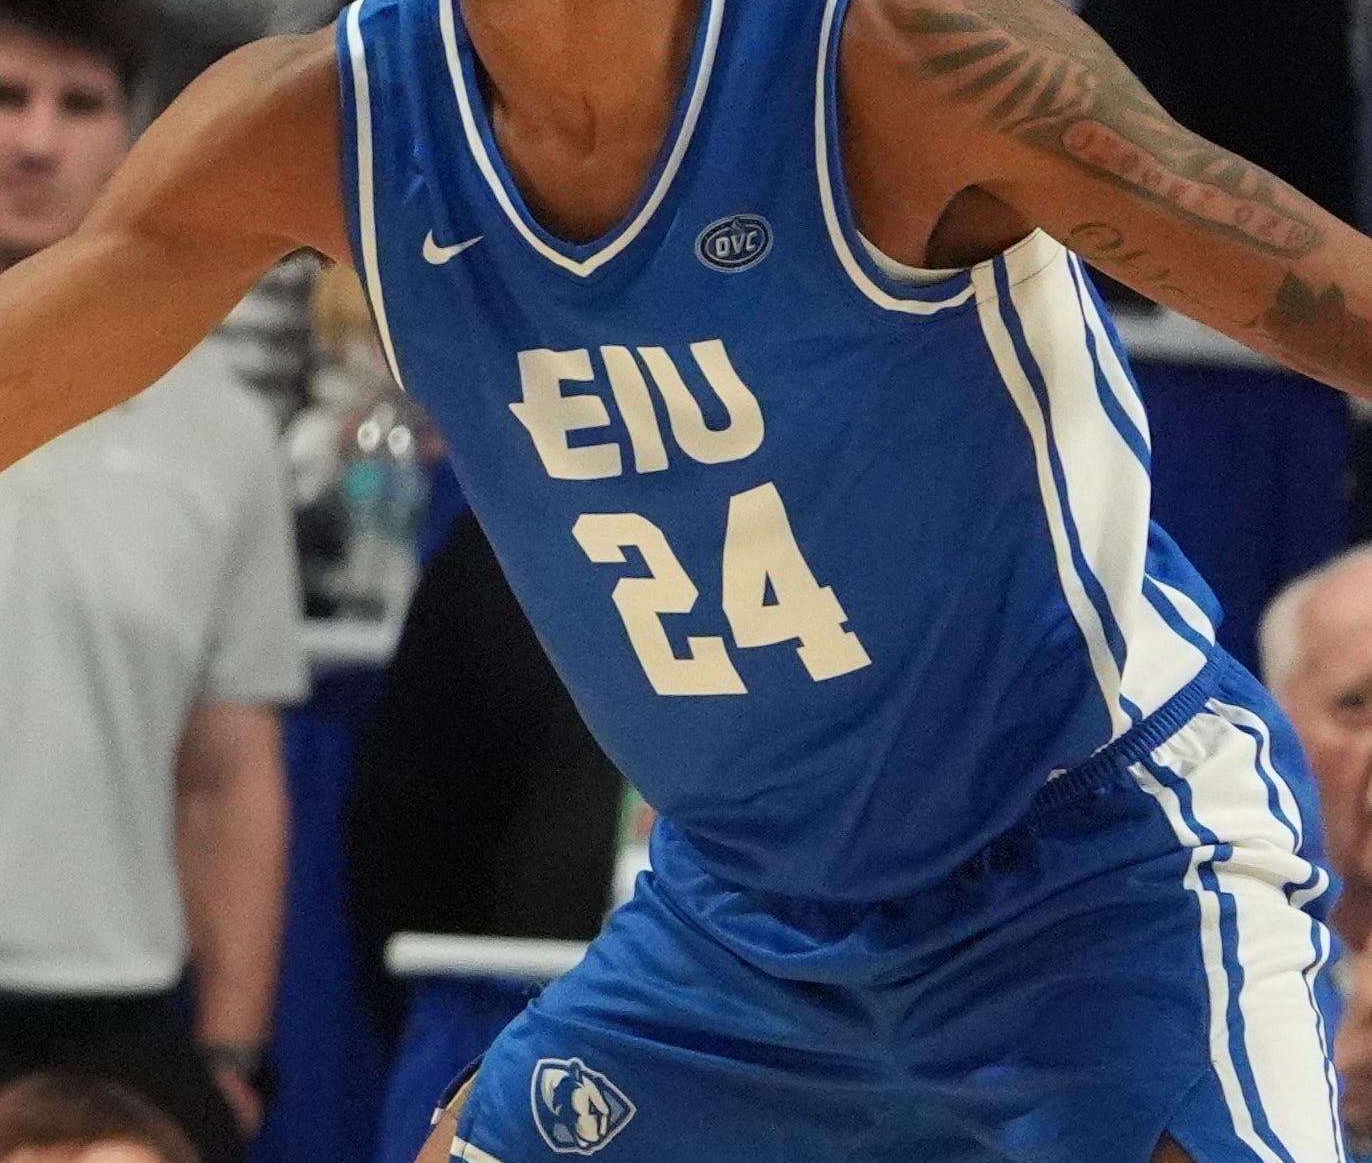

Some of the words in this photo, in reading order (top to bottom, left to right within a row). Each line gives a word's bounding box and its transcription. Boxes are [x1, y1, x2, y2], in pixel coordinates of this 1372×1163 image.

[715, 229, 759, 258] OVC
[508, 338, 765, 481] EIU
[571, 481, 873, 696] 24
